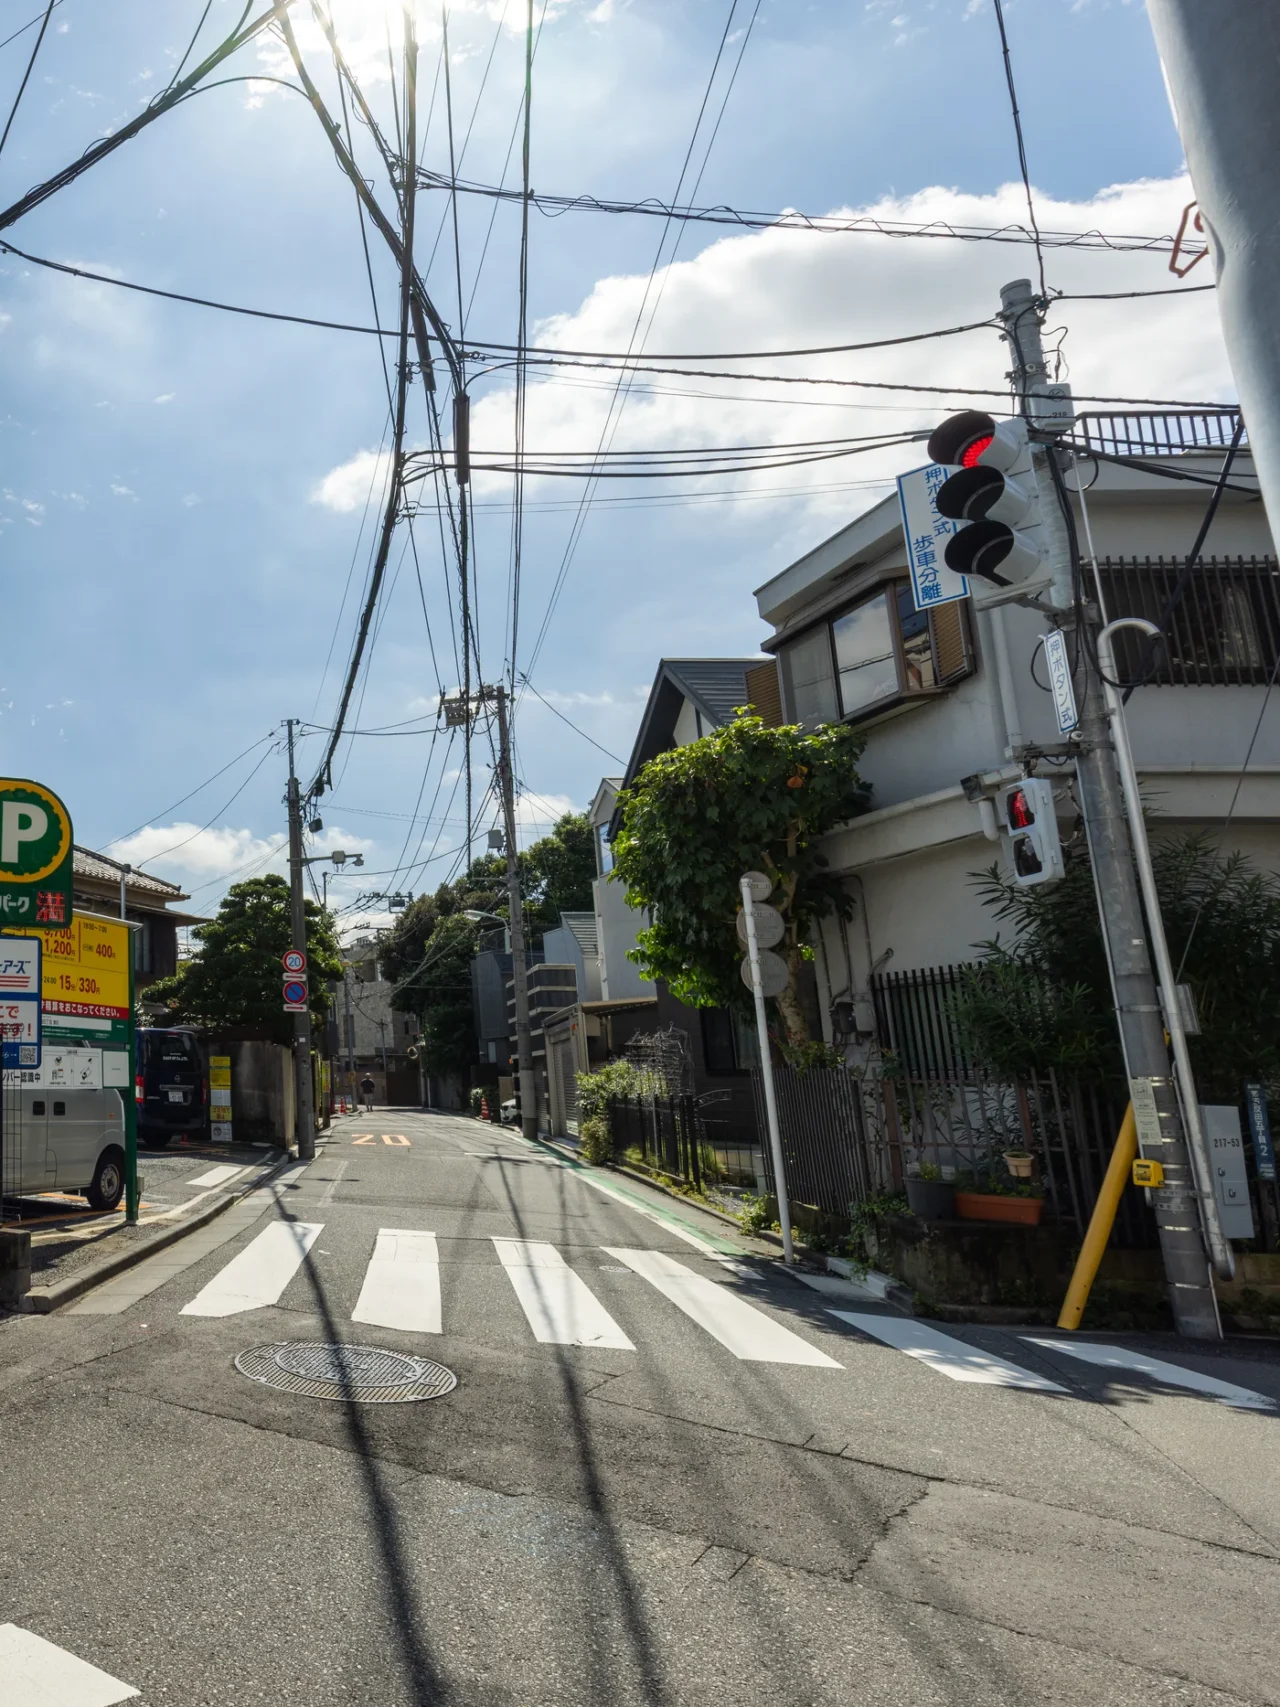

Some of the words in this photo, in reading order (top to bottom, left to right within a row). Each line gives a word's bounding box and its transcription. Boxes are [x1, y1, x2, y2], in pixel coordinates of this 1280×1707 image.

[925, 466, 951, 538] 押ボン式
[913, 533, 943, 603] 歩車分離
[1049, 639, 1073, 724] 押ボタン式
[1, 800, 48, 864] P
[35, 891, 65, 923] 満
[288, 957, 301, 967] 20
[351, 1133, 412, 1146] 20
[1213, 1138, 1241, 1148] 217-53
